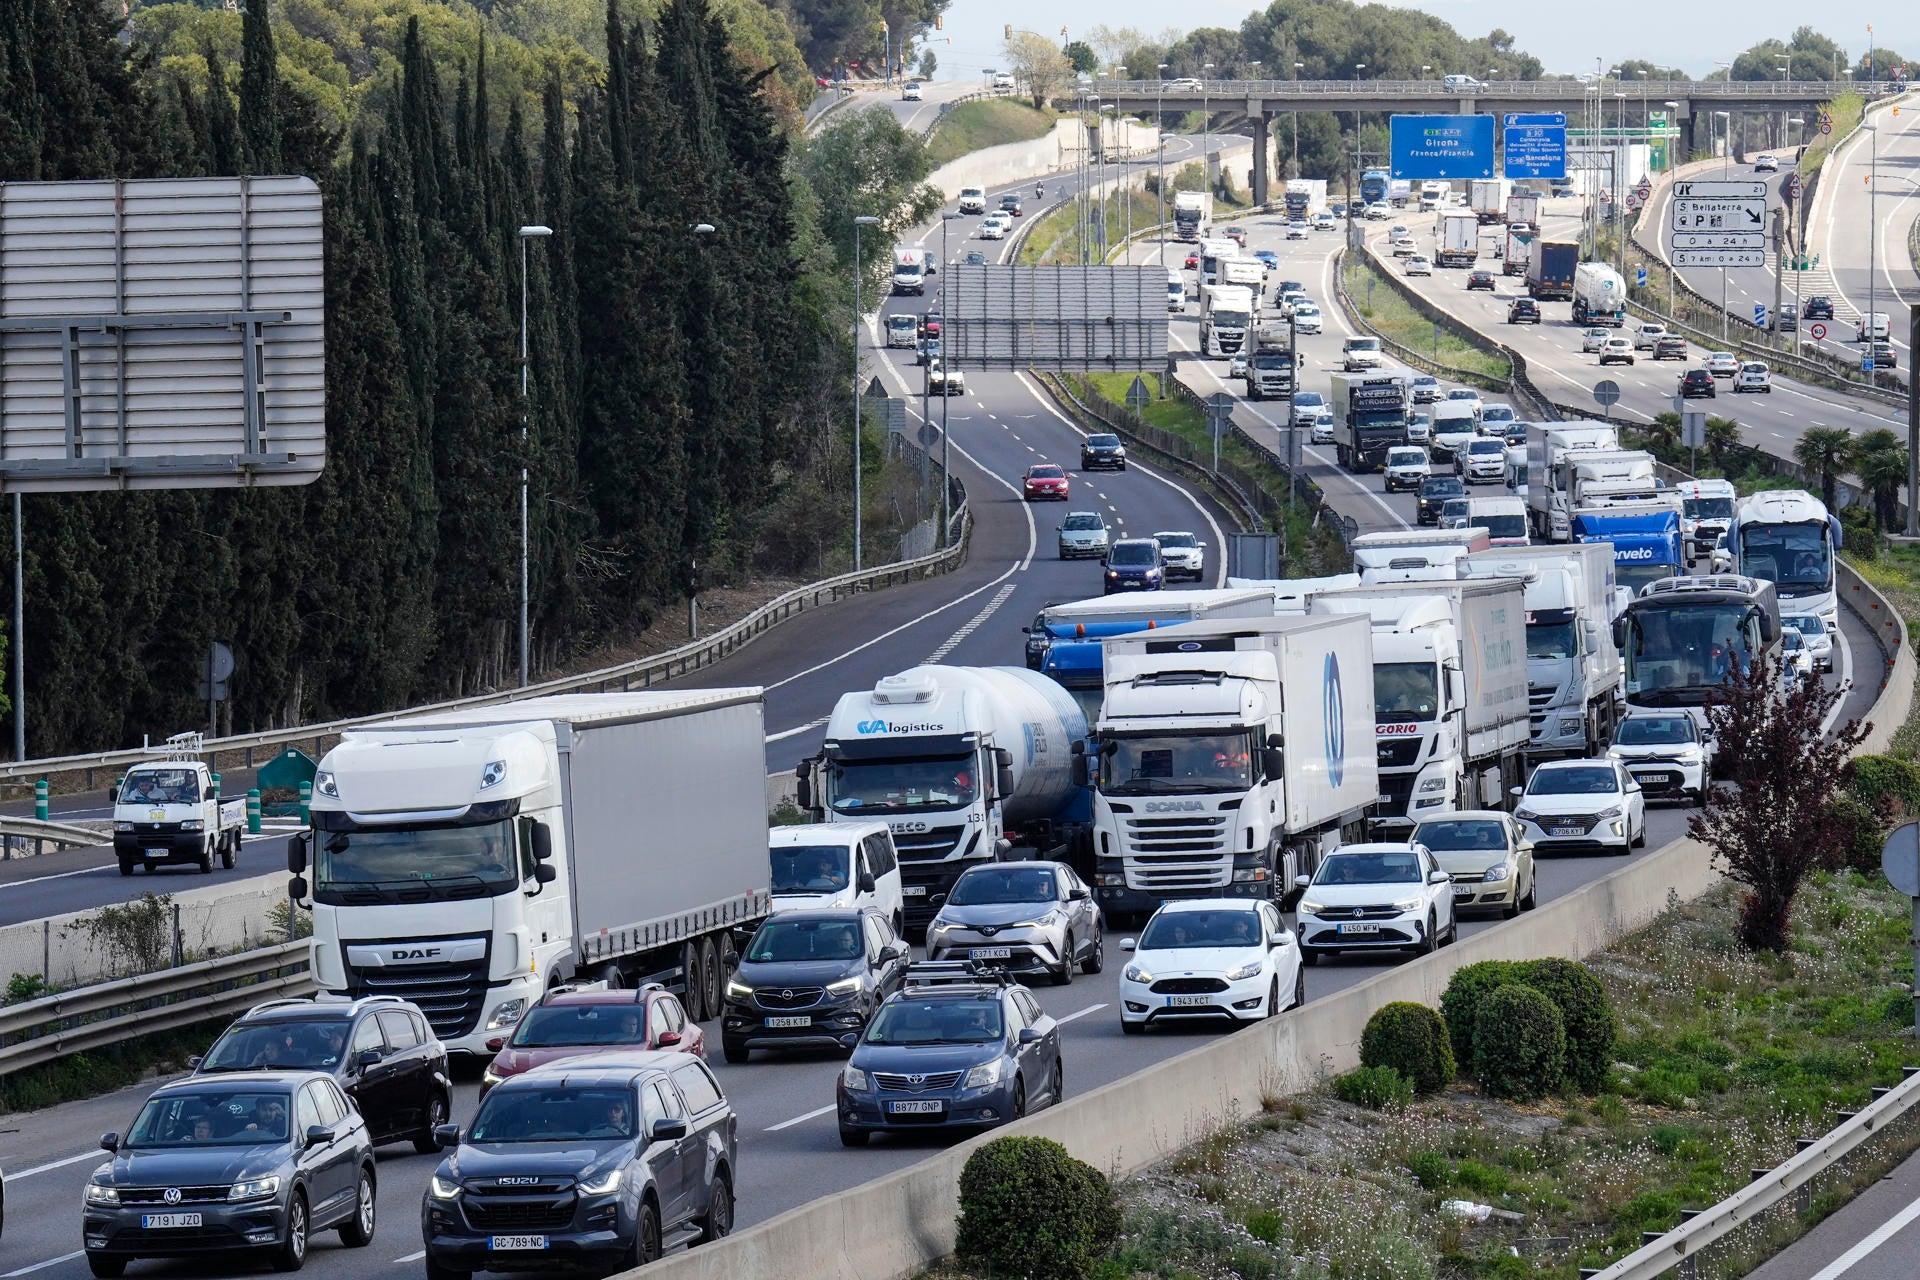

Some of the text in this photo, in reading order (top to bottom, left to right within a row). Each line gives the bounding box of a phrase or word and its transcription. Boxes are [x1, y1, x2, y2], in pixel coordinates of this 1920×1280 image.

[1425, 138, 1459, 147] Girona
[1525, 154, 1562, 162] Barcelona
[1692, 203, 1742, 211] Bellaterra
[889, 722, 944, 734] logistics
[1376, 724, 1417, 734] GORIO
[1145, 801, 1205, 812] SCANIA
[967, 813, 985, 823] 131
[1343, 924, 1361, 932] 1450
[392, 949, 440, 960] DAF
[974, 949, 1008, 958] 6371 KCX
[1173, 996, 1209, 1005] 1943 KCT
[794, 1017, 809, 1026] KTF
[895, 1102, 939, 1111] 8877 GNP
[498, 1177, 539, 1185] ISUZU
[149, 1214, 200, 1226] 7191 JZD
[494, 1237, 543, 1247] GC-789-NC
